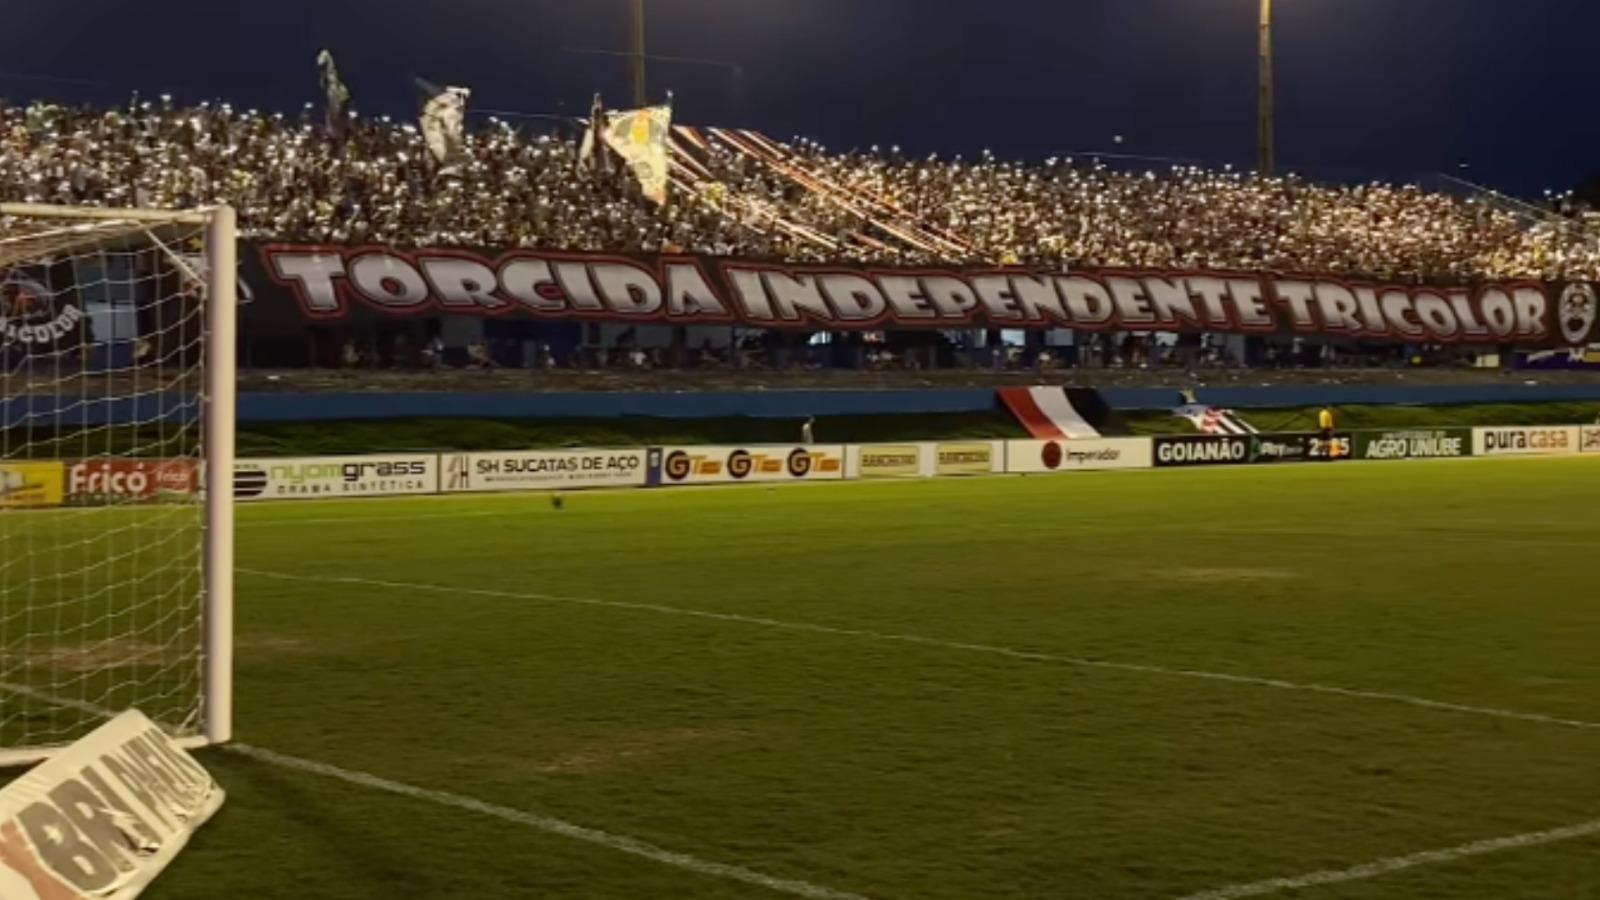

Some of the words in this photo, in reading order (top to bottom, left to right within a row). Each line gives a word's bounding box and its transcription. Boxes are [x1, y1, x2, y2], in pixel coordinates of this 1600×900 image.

[272, 252, 727, 317] TORCIDA
[727, 268, 1272, 327] INDEPENDENTE
[1276, 281, 1547, 338] TRICOLOR
[1158, 438, 1245, 462] GOIANÃO
[1365, 439, 1407, 459] AGRO
[1410, 437, 1462, 456] UNIUBE
[476, 459, 499, 474] SH
[504, 457, 578, 473] SUCATAS
[582, 456, 602, 470] DE
[606, 455, 640, 472] AÇO
